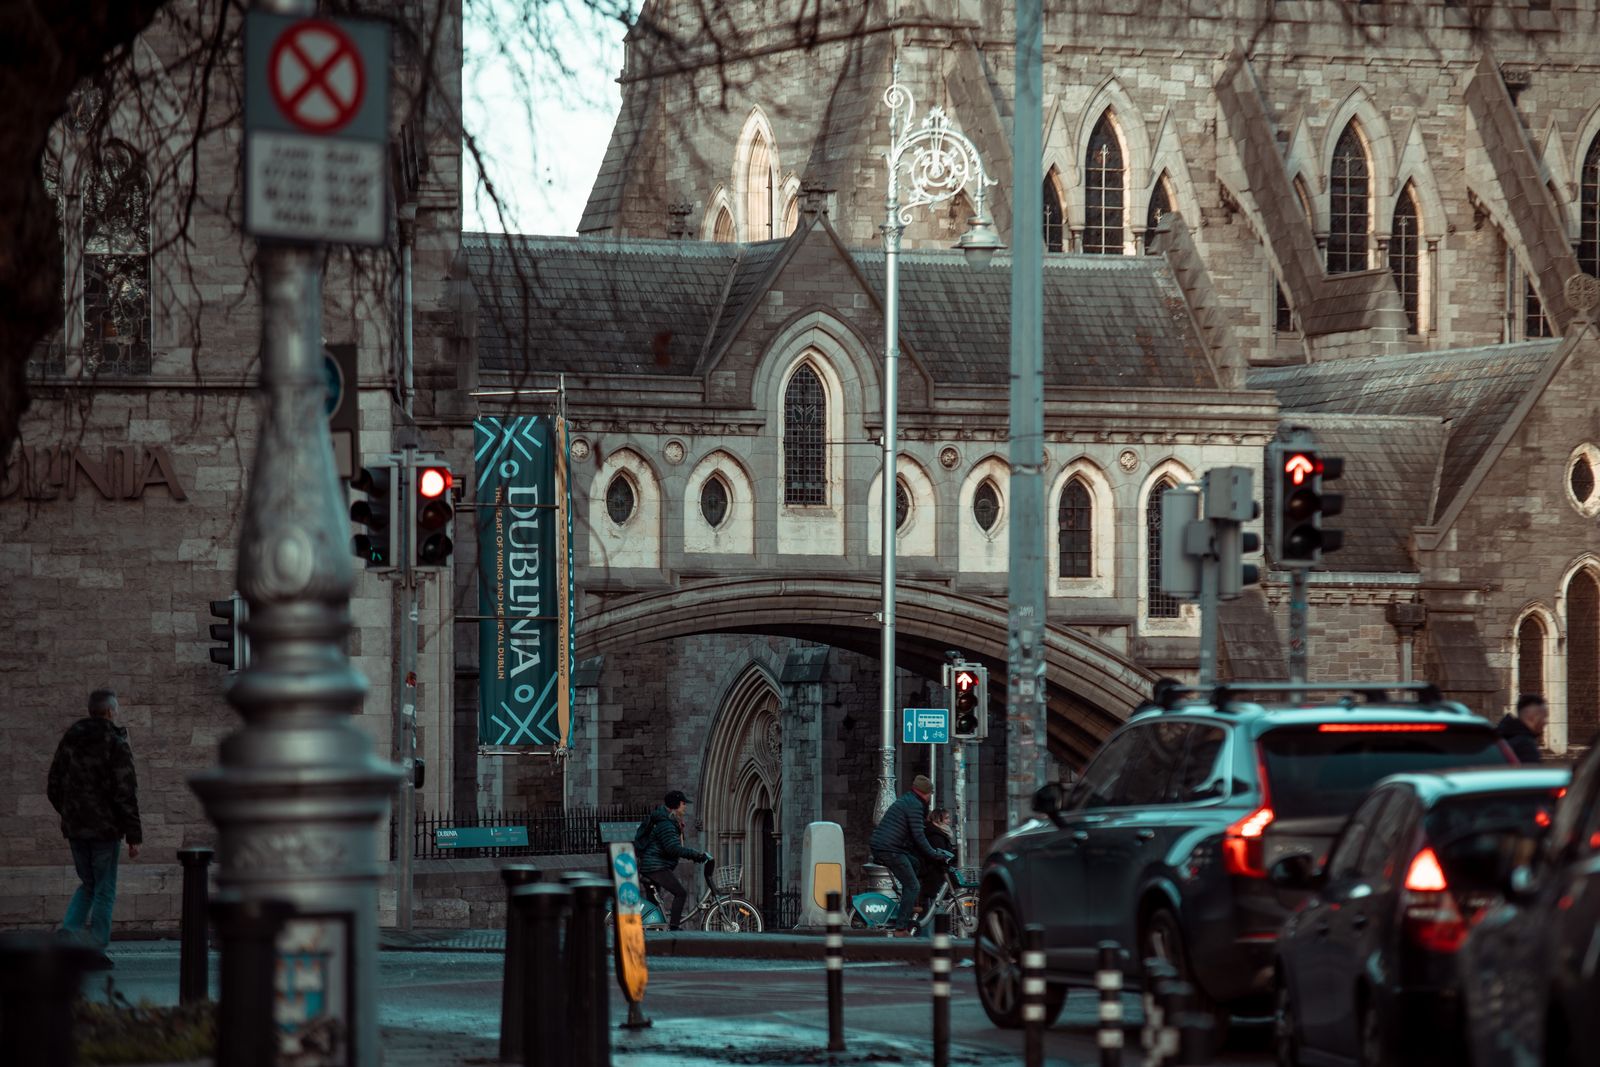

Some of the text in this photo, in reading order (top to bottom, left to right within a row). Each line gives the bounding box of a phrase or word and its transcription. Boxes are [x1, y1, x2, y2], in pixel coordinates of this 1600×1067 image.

[496, 536, 503, 547] OF
[496, 549, 504, 580] VIKING
[508, 483, 540, 678] DUBLINIA
[865, 904, 887, 913] NOW
